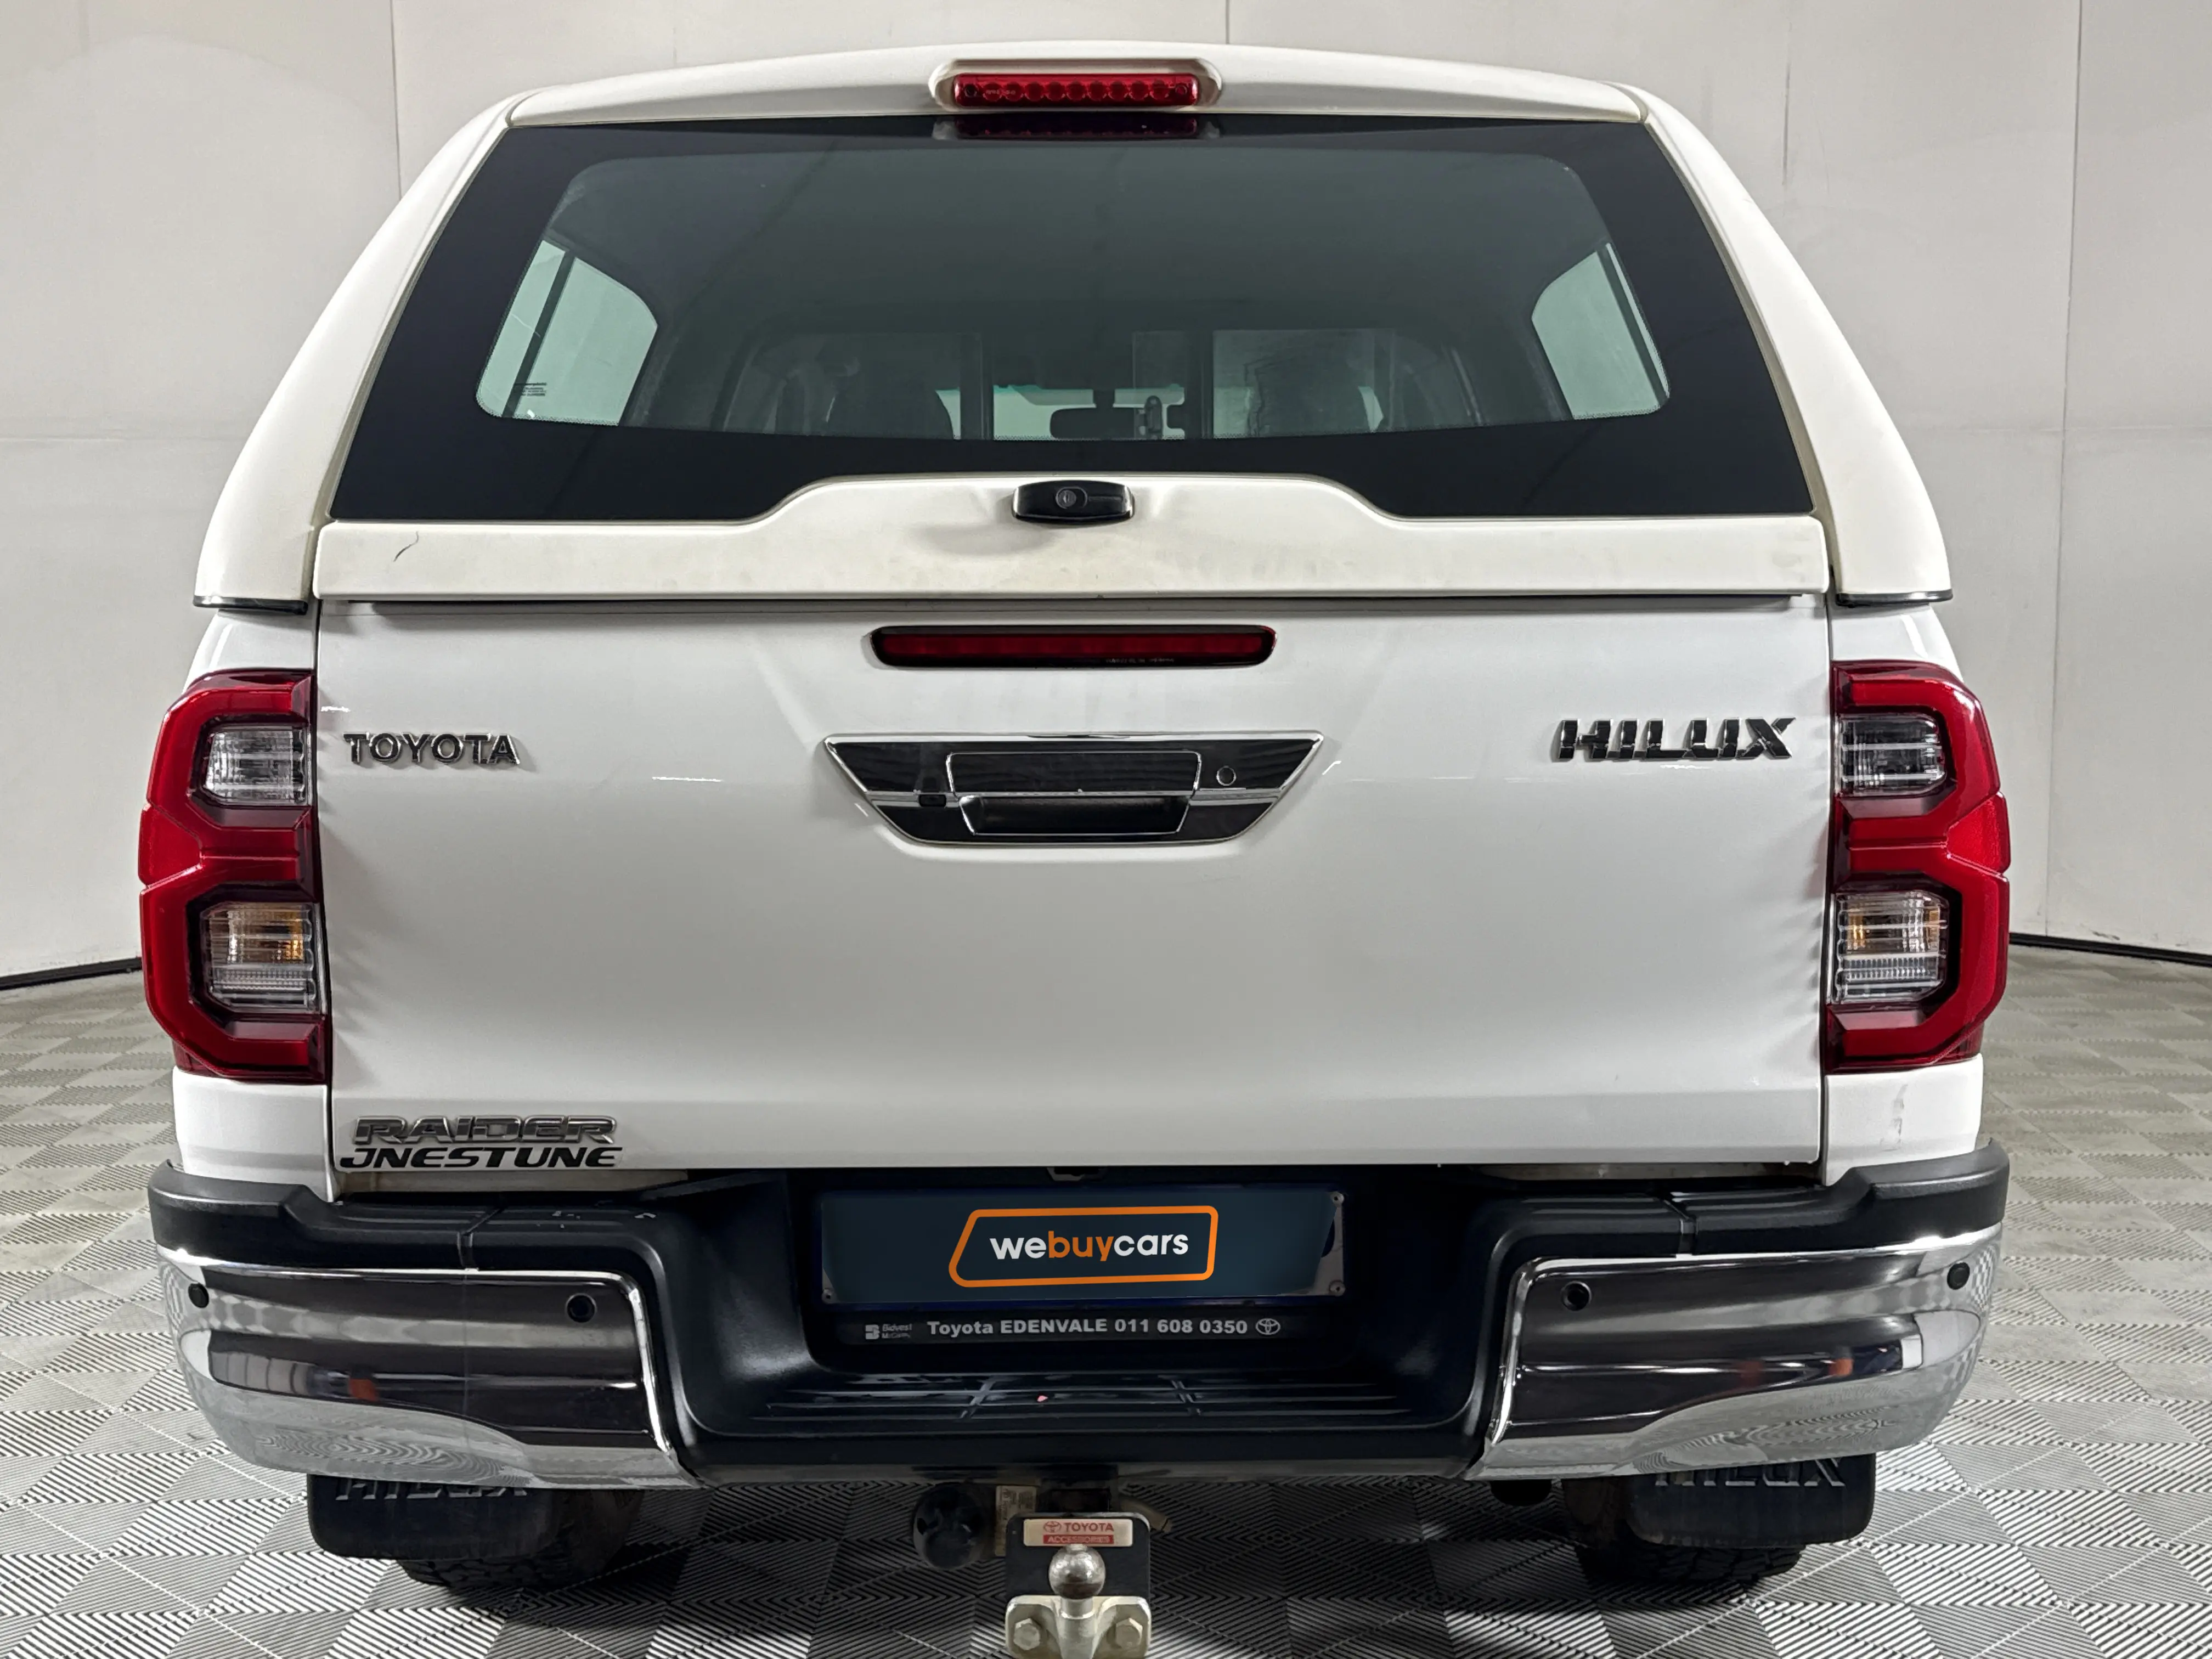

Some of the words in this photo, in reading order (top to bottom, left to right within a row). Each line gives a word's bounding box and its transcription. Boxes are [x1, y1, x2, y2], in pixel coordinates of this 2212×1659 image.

[343, 731, 520, 764] TOYOTA
[1558, 718, 1796, 760] HILUX
[352, 1115, 617, 1144] RAIDER
[340, 1147, 622, 1168] JNESTUNE
[927, 1321, 994, 1338] Toyota
[1000, 1319, 1108, 1334] EDENVALE
[1115, 1319, 1149, 1332] 011
[1157, 1319, 1193, 1334] 608
[1199, 1320, 1248, 1334] 0350
[1064, 1522, 1114, 1532] TOYOTA
